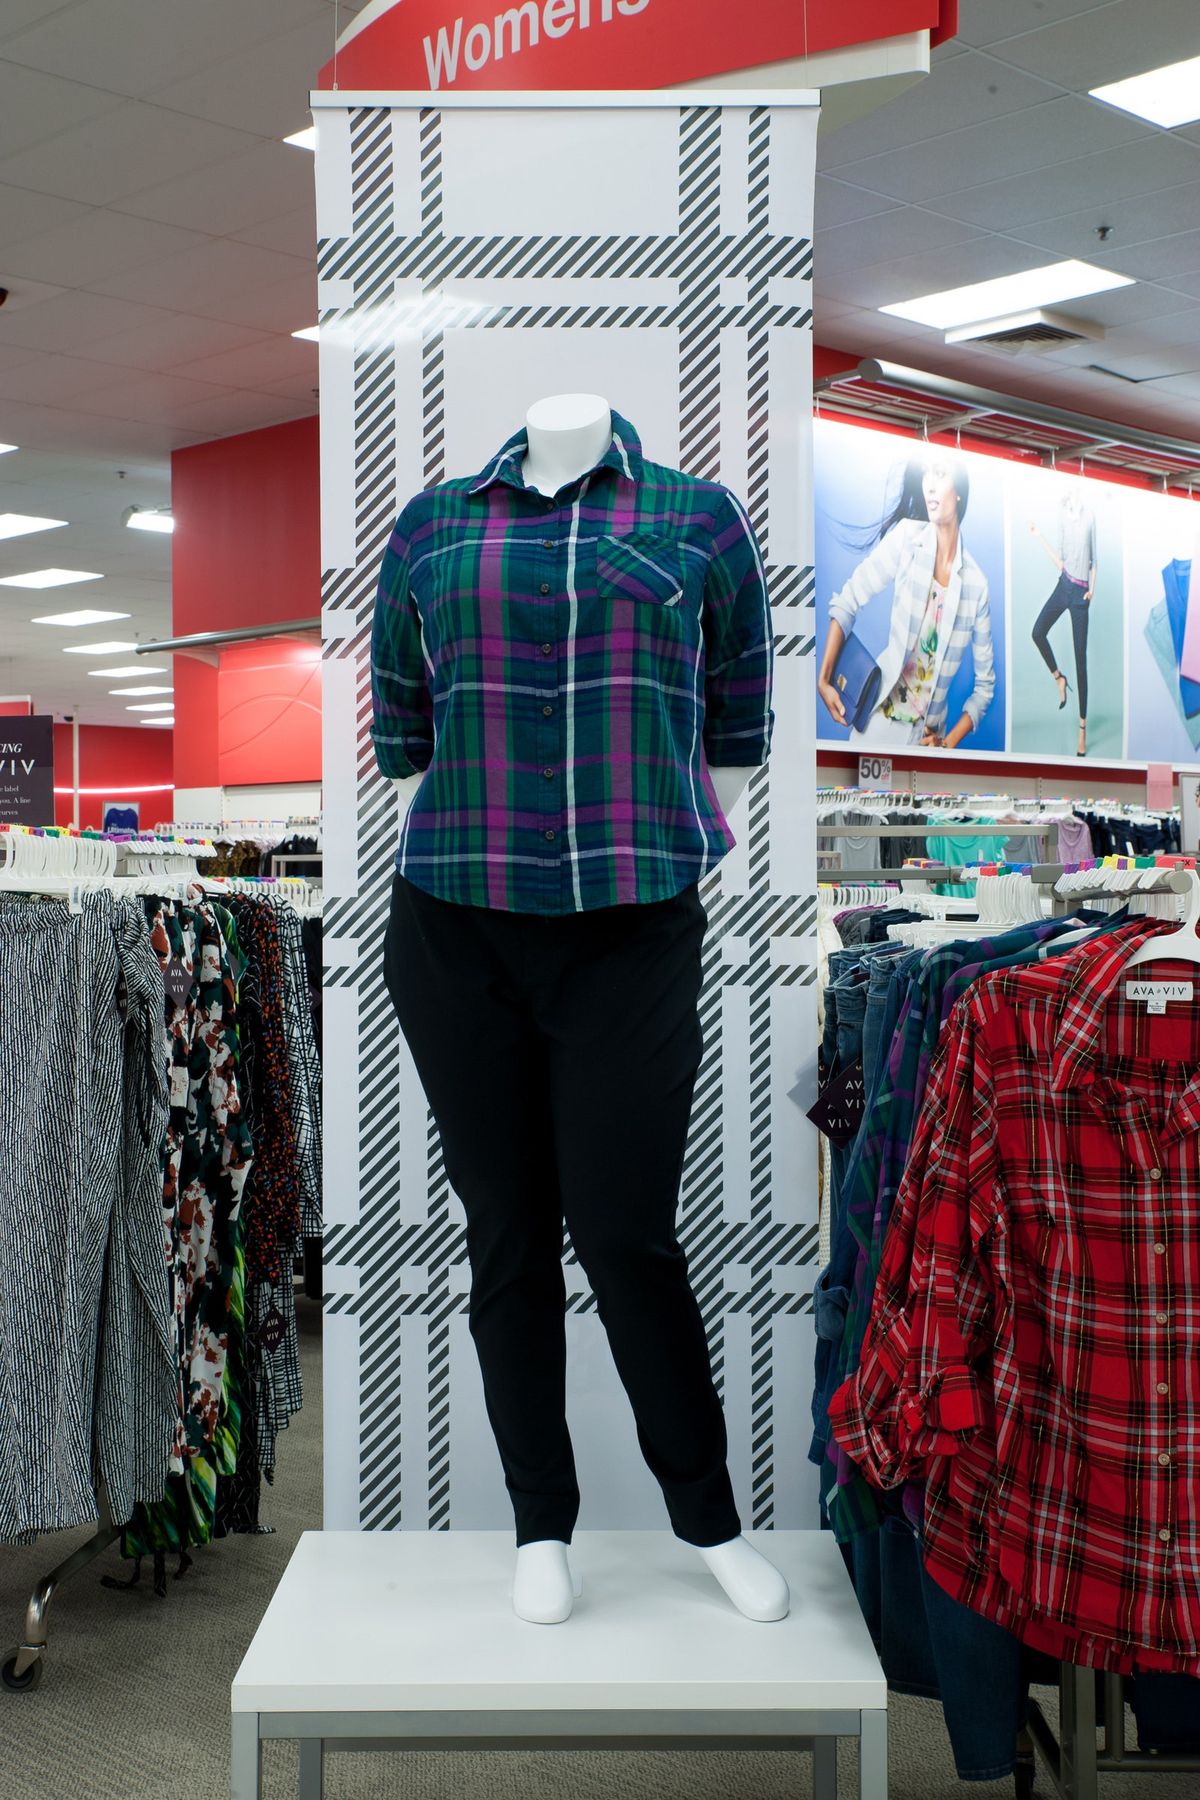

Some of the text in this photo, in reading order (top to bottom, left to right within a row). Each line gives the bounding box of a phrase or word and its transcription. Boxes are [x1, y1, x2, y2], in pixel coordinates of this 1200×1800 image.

[860, 758, 891, 779] 50%
[171, 969, 183, 977] AVA
[1133, 987, 1155, 995] AVA
[1163, 987, 1185, 995] VIV
[845, 1080, 865, 1089] AV
[267, 1318, 279, 1328] AVA
[267, 1331, 279, 1340] VIV
